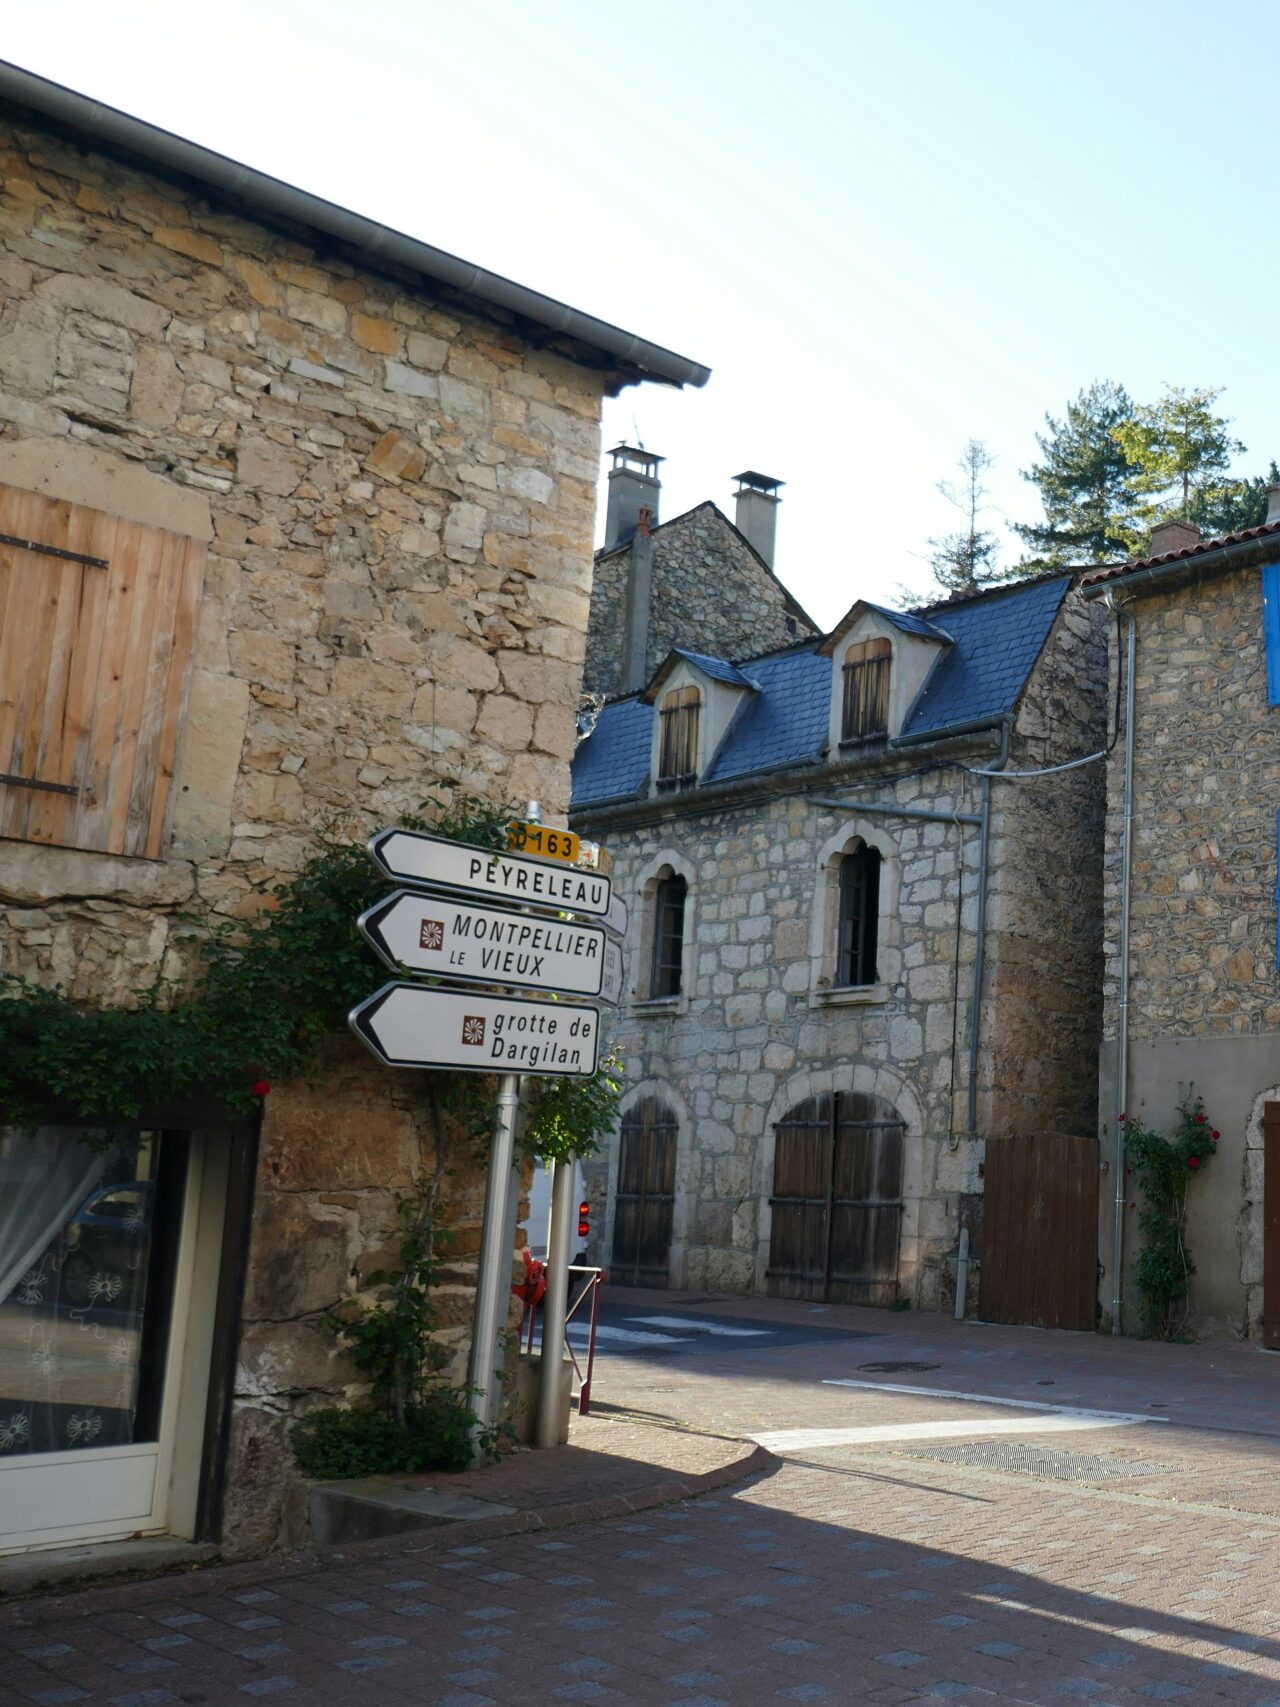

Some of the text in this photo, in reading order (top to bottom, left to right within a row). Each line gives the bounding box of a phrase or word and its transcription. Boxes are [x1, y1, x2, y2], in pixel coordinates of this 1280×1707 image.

[535, 831, 572, 857] 163
[469, 858, 603, 905] PEYRELEAU
[452, 914, 599, 958] MONTPELLIER
[450, 948, 545, 977] LE VIEUX
[493, 1013, 591, 1038] grotte de
[491, 1037, 580, 1067] Dargilan
